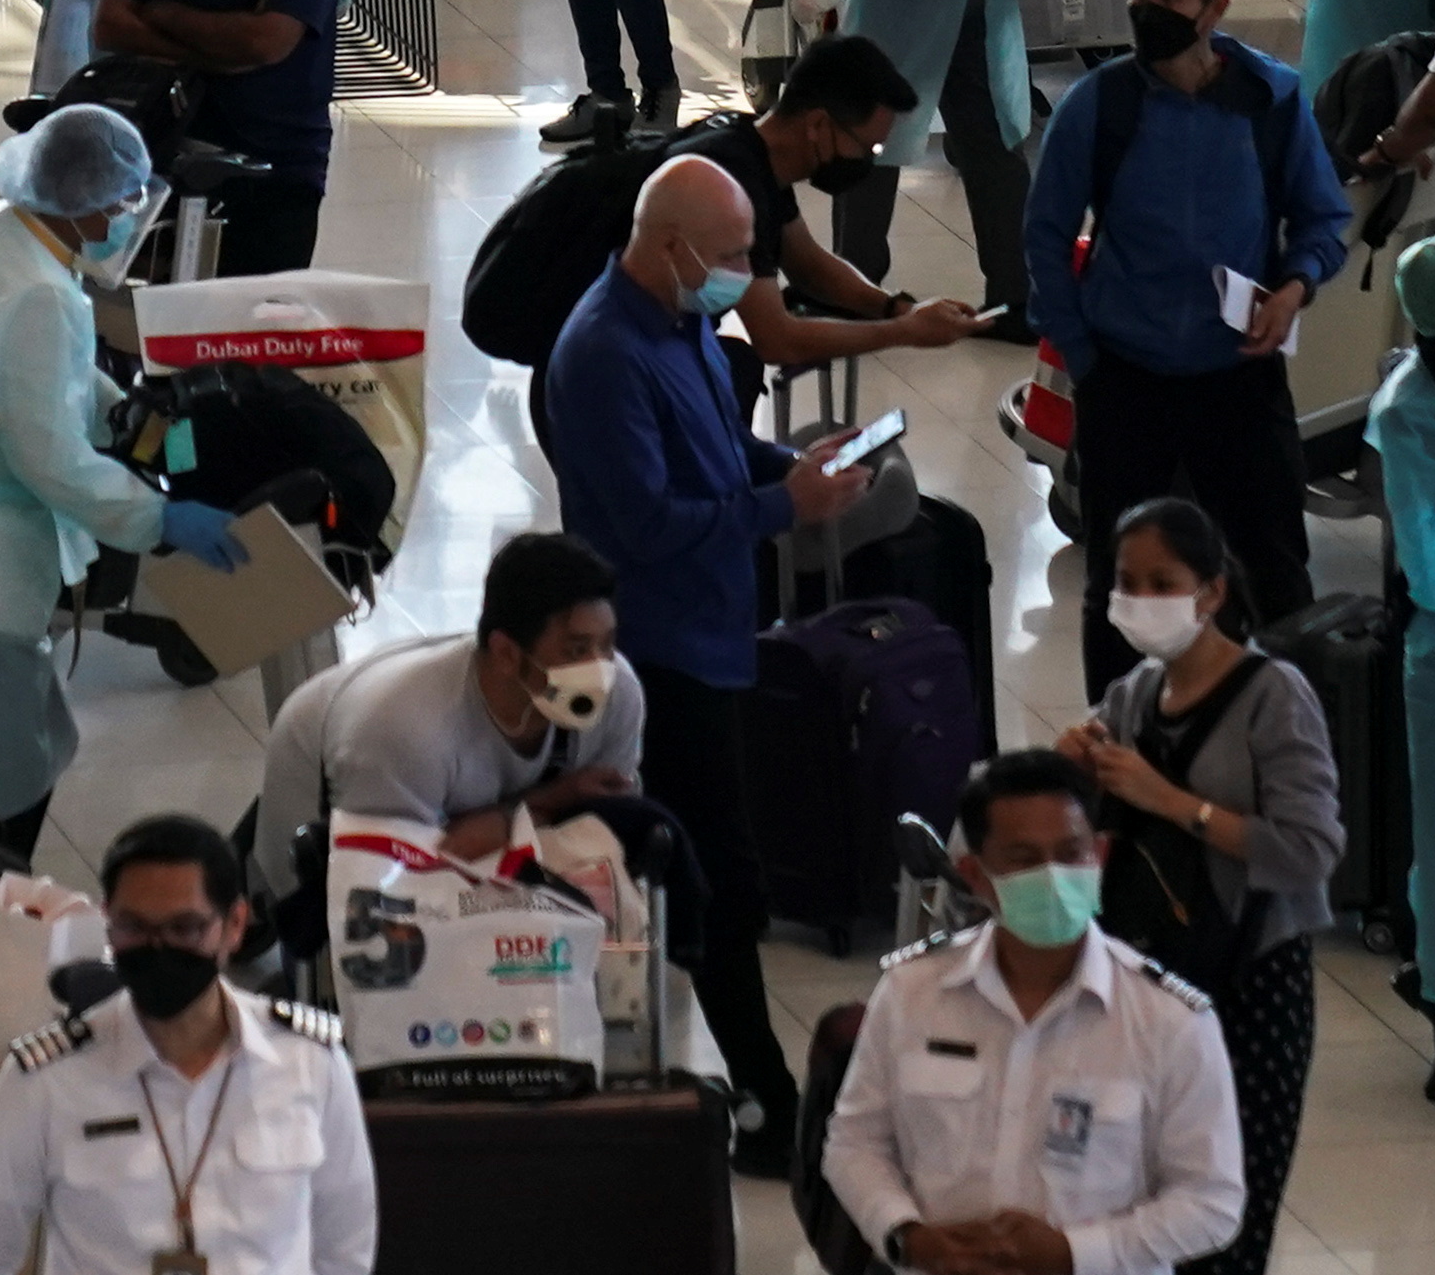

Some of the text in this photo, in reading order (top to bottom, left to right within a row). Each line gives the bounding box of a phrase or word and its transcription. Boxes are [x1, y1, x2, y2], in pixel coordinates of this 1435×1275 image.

[195, 335, 364, 361] Dubai Duty Free
